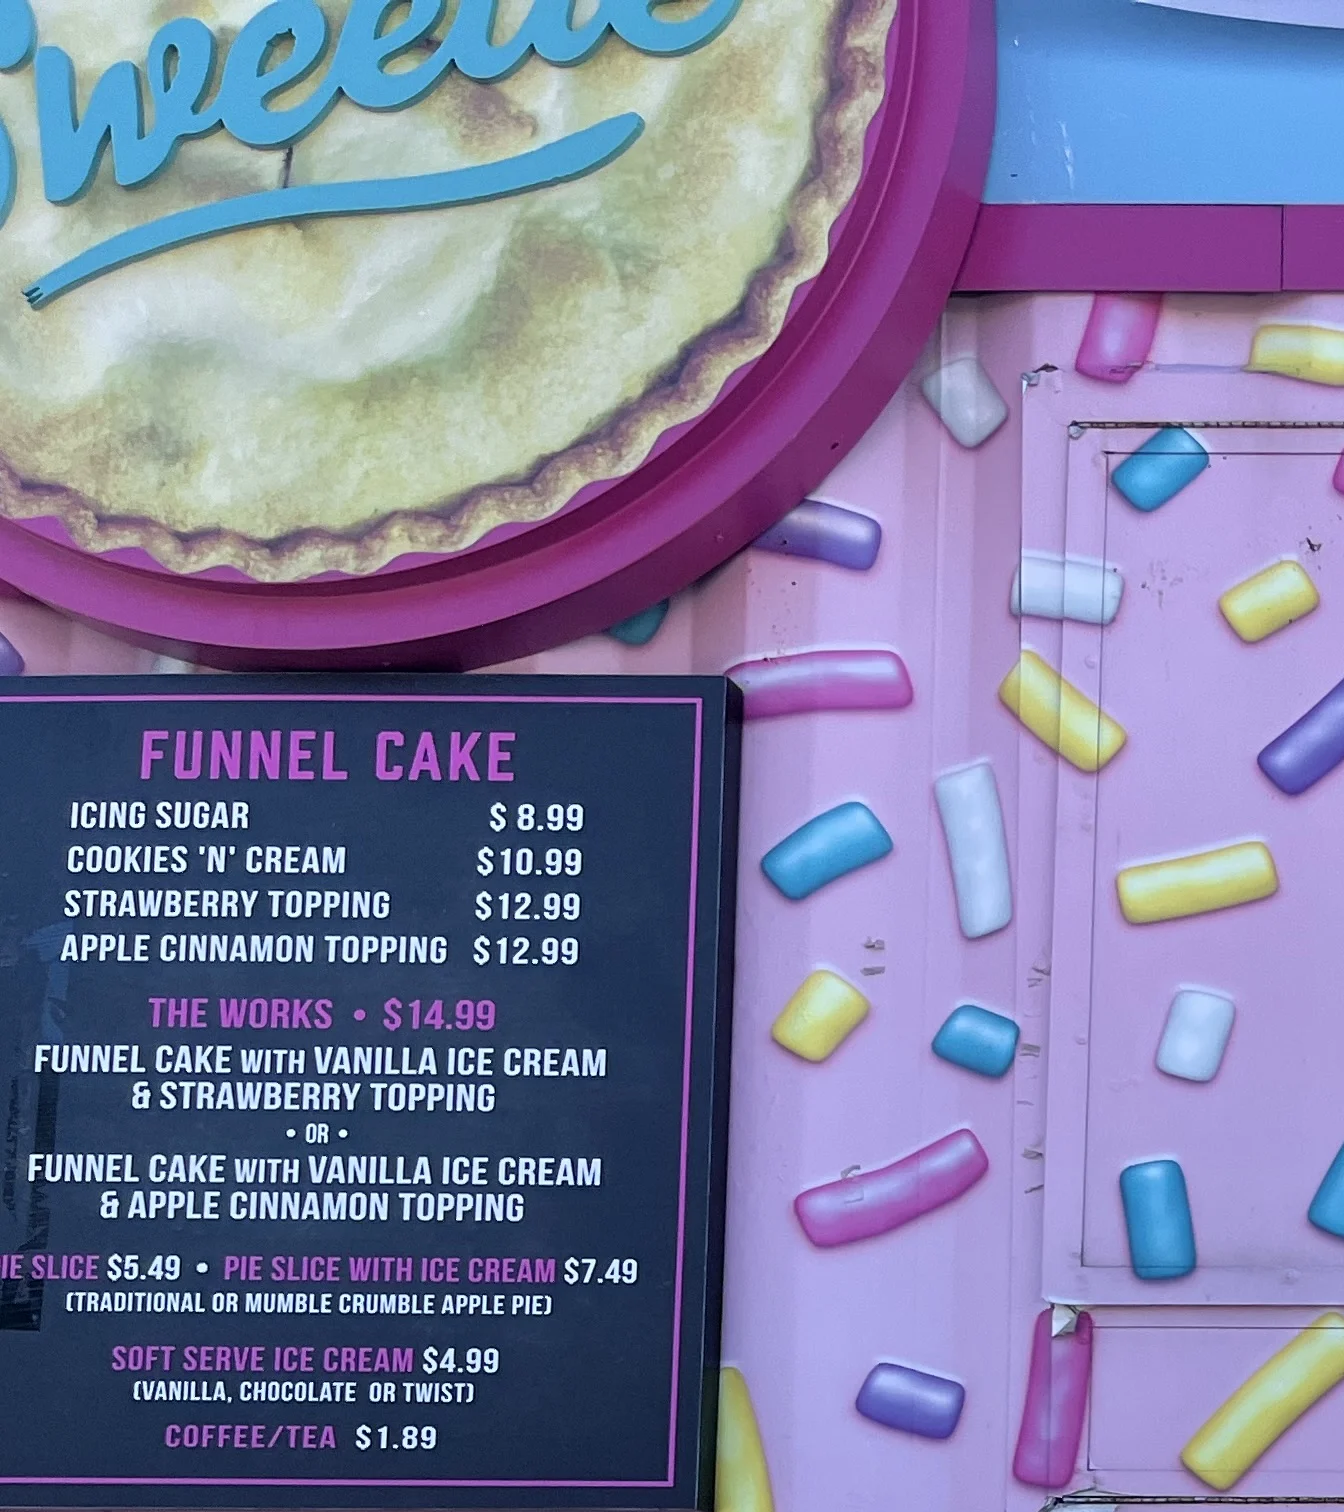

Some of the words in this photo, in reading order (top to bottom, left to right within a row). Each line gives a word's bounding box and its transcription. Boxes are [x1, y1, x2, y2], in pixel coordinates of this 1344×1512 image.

[139, 729, 348, 781] FUNNEL
[375, 730, 516, 782] CAKE
[70, 801, 147, 829] ICING
[154, 800, 249, 829] SUGAR
[67, 845, 189, 874] COOKIES
[198, 845, 236, 873] 'N'
[245, 845, 346, 874] CREAM
[476, 845, 582, 877] $10.99
[63, 889, 259, 918] STRAWBERRY
[267, 889, 391, 919] TOPPING
[474, 890, 581, 921] $12.99
[59, 933, 151, 962] APPLE
[159, 933, 315, 963] CINNAMON
[323, 935, 448, 964] TOPPING
[472, 934, 579, 966] $12.99
[148, 997, 209, 1029] THE
[219, 997, 333, 1030] WORKS
[382, 997, 496, 1032] $14.99
[34, 1044, 147, 1073] FUNNEL
[154, 1044, 233, 1074] CAKE
[239, 1048, 306, 1075] WITH
[313, 1045, 438, 1076] VANILLA
[447, 1047, 495, 1076] ICE
[503, 1047, 607, 1077] CREAM
[131, 1080, 152, 1110] &
[159, 1080, 362, 1111] STRAWBERRY
[369, 1082, 496, 1113] TOPPING
[305, 1122, 330, 1144] OR
[27, 1153, 140, 1183] FUNNEL
[148, 1153, 227, 1183] CAKE
[233, 1157, 300, 1184] WITH
[307, 1154, 432, 1185] VANILLA
[441, 1156, 489, 1186] ICE
[497, 1156, 602, 1187] CREAM
[99, 1190, 120, 1219] &
[127, 1190, 221, 1220] APPLE
[229, 1190, 389, 1221] CINNAMON
[398, 1192, 525, 1222] TOPPING
[0, 1254, 25, 1279] IE
[31, 1253, 100, 1280] SLICE
[106, 1252, 181, 1282] $5.49
[224, 1255, 264, 1281] PIE
[270, 1255, 342, 1282] SLICE
[348, 1256, 413, 1282] WITH
[420, 1257, 461, 1283] ICE
[467, 1257, 556, 1283] CREAM
[563, 1256, 638, 1285] $7.49
[65, 1291, 206, 1313] (TRADITIONAL
[211, 1292, 239, 1313] OR
[244, 1292, 333, 1315] MUMBLE
[338, 1293, 436, 1315] CRUMBLE
[440, 1294, 506, 1315] APPLE
[511, 1294, 552, 1316] PIE)
[111, 1345, 177, 1371] SOFT
[182, 1345, 266, 1372] SERVE
[273, 1346, 315, 1372] ICE
[323, 1346, 414, 1373] CREAM
[422, 1346, 500, 1375] $4.99
[132, 1380, 233, 1404] (VANILLA,
[239, 1380, 357, 1403] CHOCOLATE
[368, 1381, 396, 1403] OR
[402, 1382, 475, 1403] TWIST)
[165, 1424, 336, 1449] COFFEE/TEA
[355, 1424, 437, 1451] $1.89
